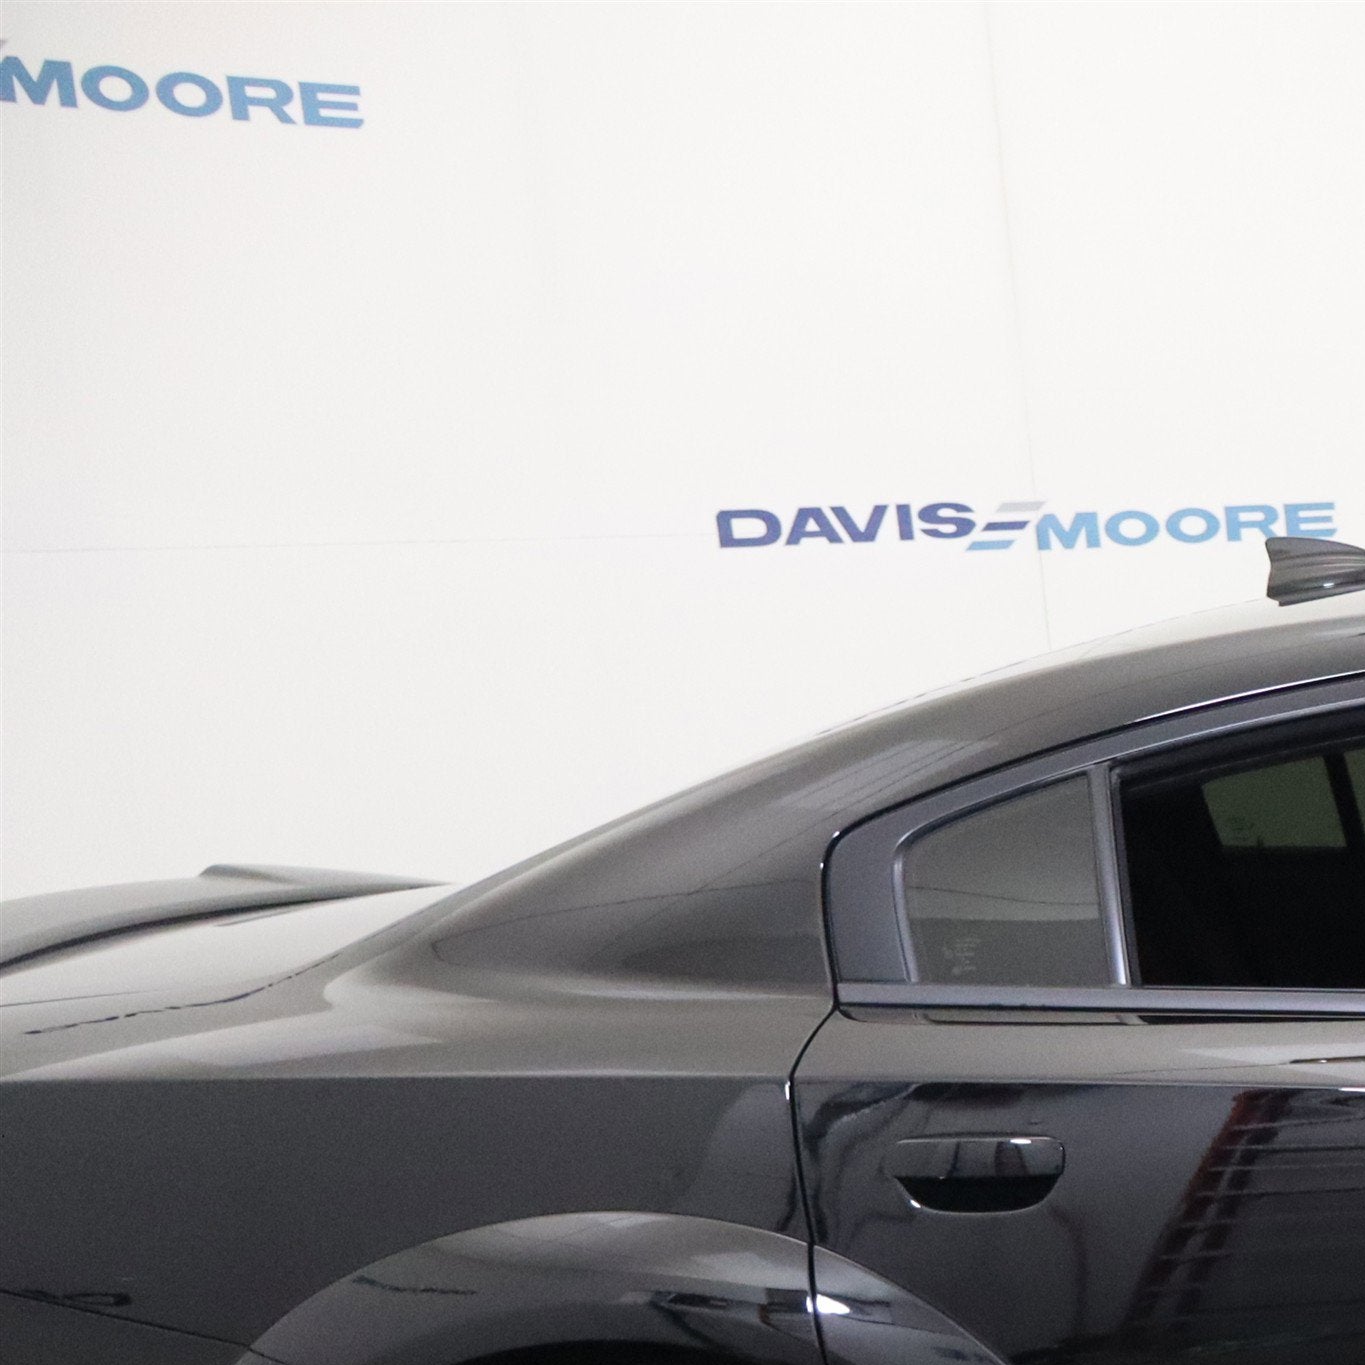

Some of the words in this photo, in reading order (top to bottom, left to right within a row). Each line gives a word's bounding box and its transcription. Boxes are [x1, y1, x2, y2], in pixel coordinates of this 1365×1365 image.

[0, 55, 364, 129] MOORE
[715, 501, 977, 549] DAVIS
[1035, 501, 1338, 552] MOORE
